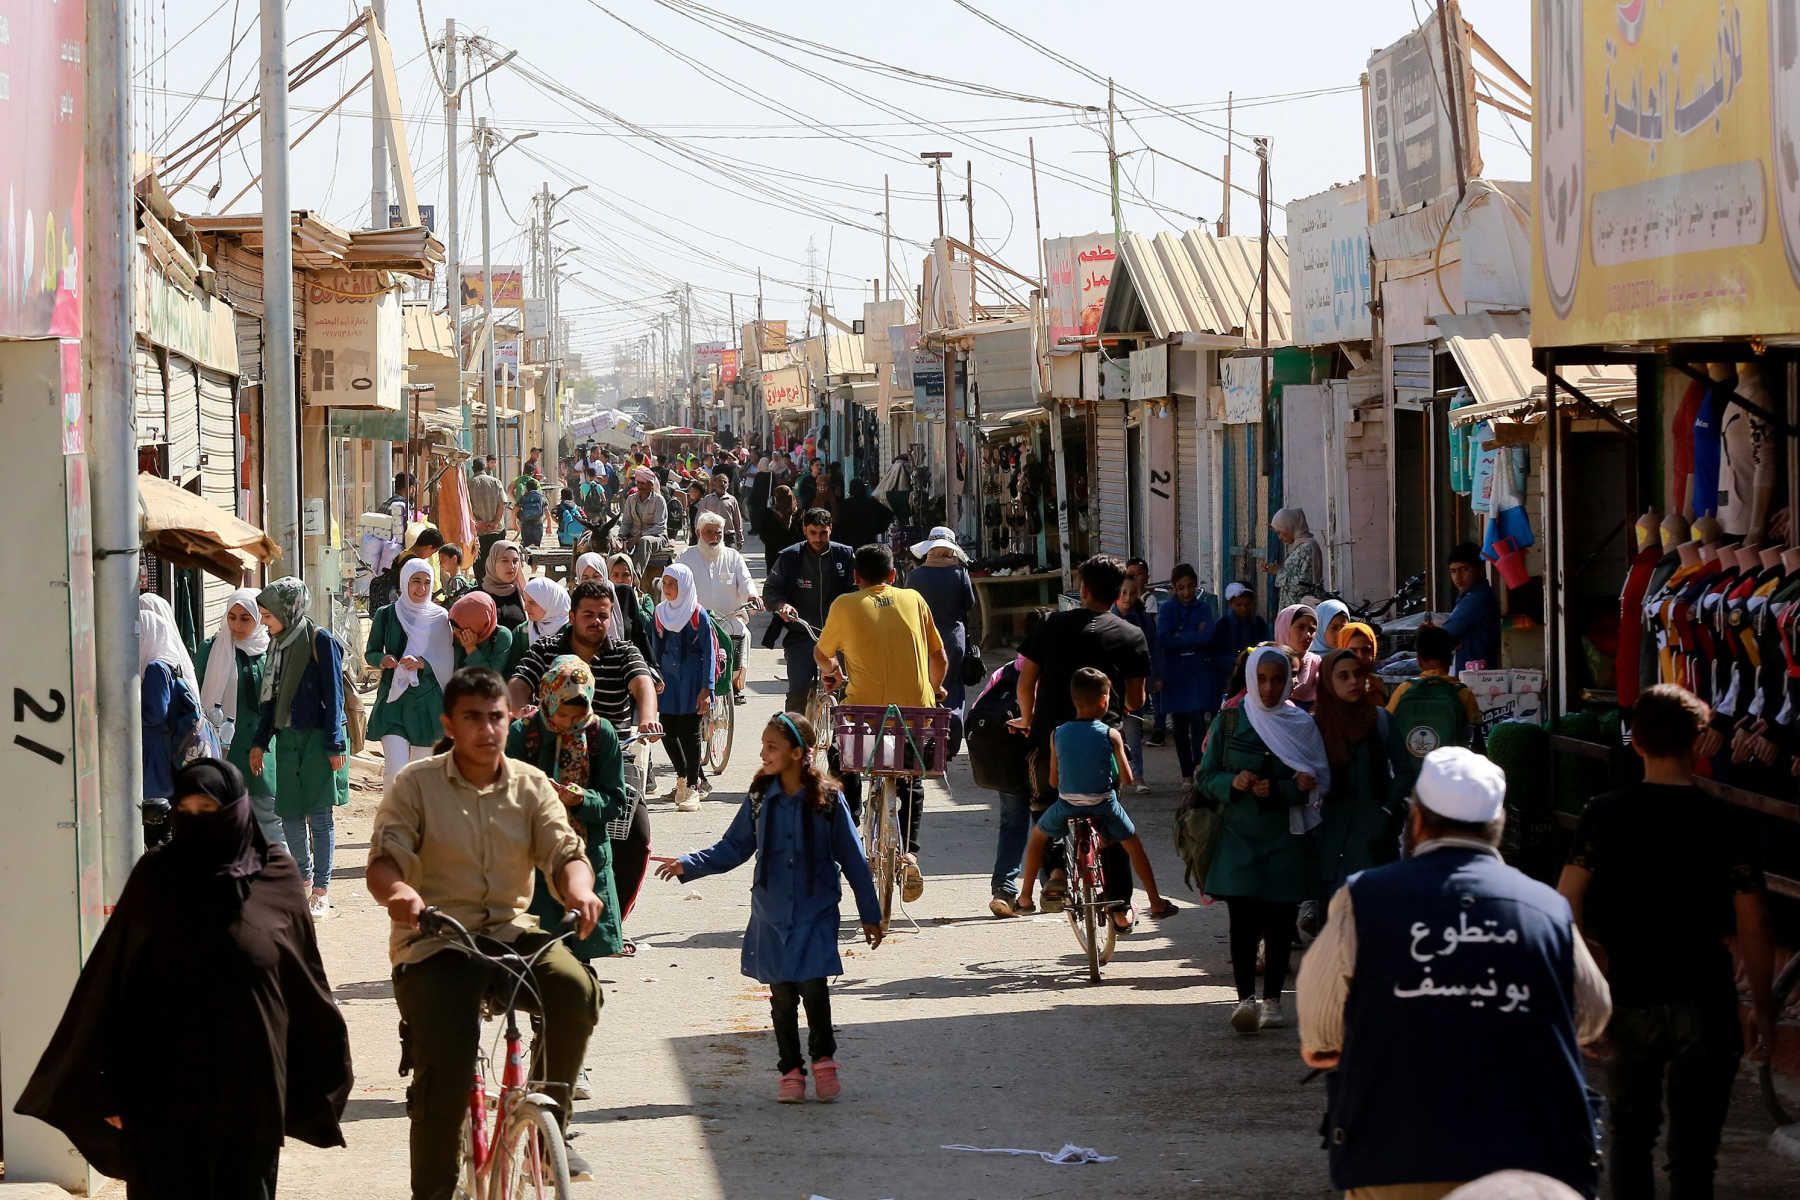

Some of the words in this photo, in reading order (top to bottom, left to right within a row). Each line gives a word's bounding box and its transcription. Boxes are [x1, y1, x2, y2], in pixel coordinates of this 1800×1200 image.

[1078, 244, 1117, 267] طعم
[1410, 911, 1518, 962] متطوع
[1394, 966, 1530, 1012] يونيسف
